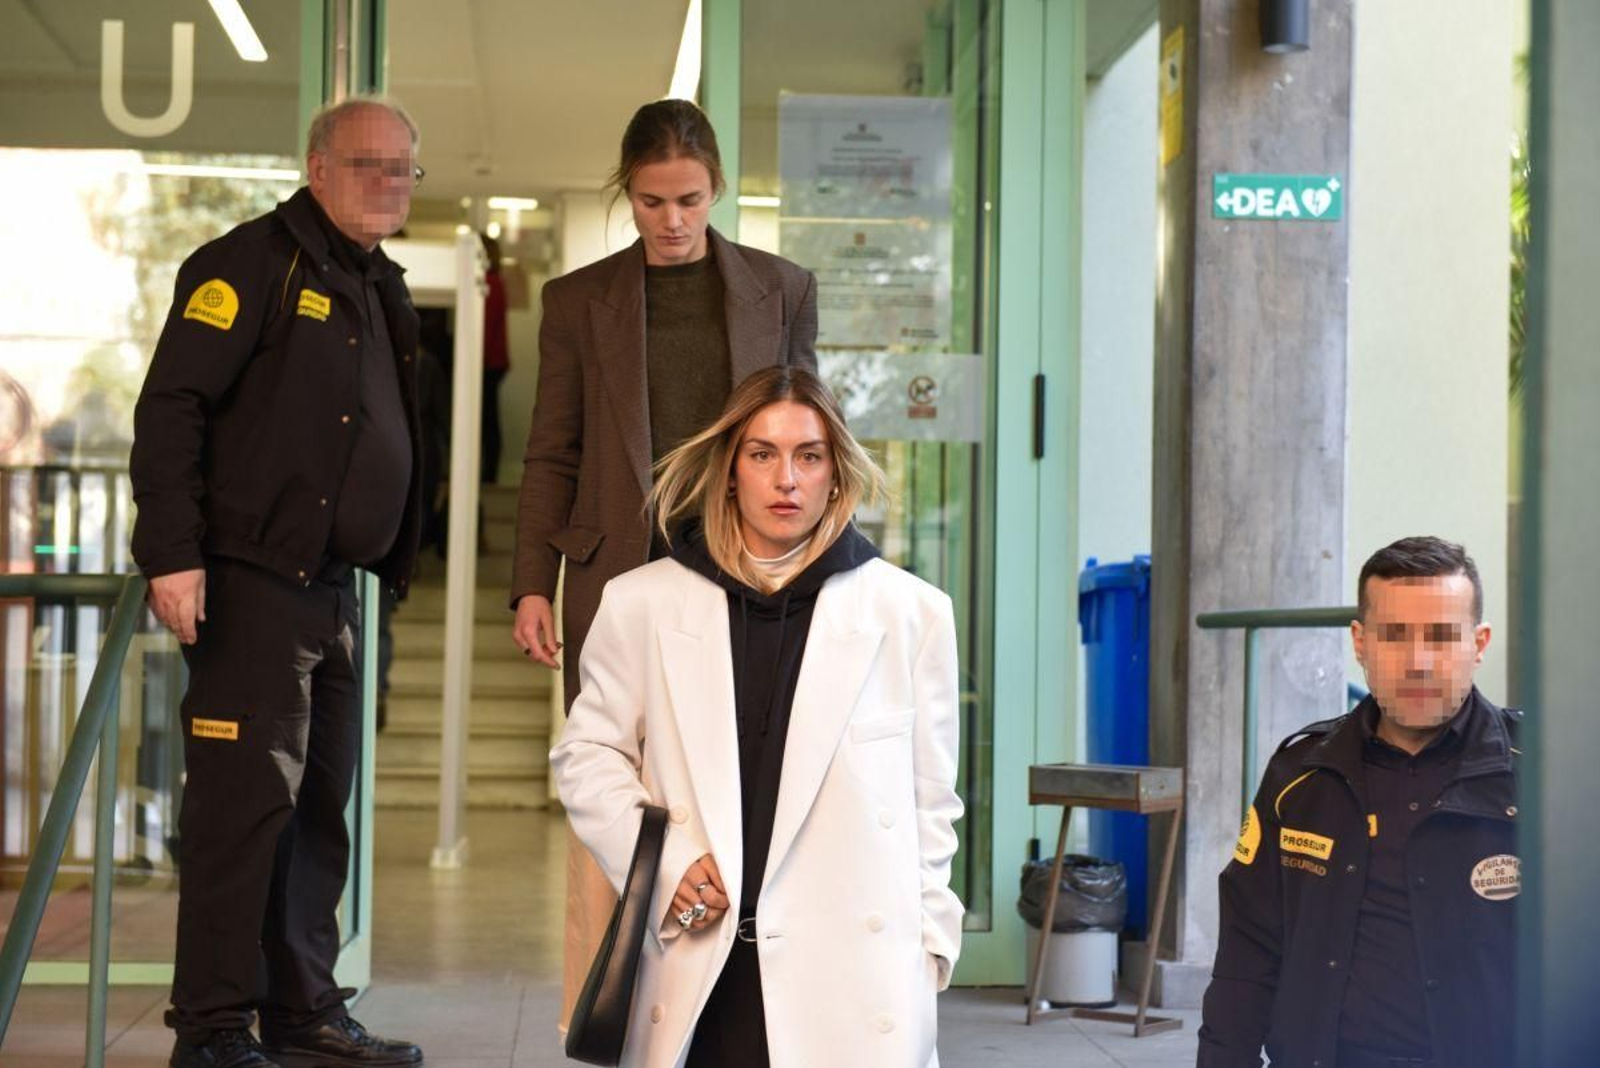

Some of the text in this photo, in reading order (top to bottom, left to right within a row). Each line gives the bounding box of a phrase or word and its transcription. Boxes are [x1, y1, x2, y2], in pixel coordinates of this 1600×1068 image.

[101, 19, 194, 137] U
[1232, 187, 1300, 217] DEA
[1474, 875, 1521, 888] SEGURID
[1494, 867, 1506, 877] DE
